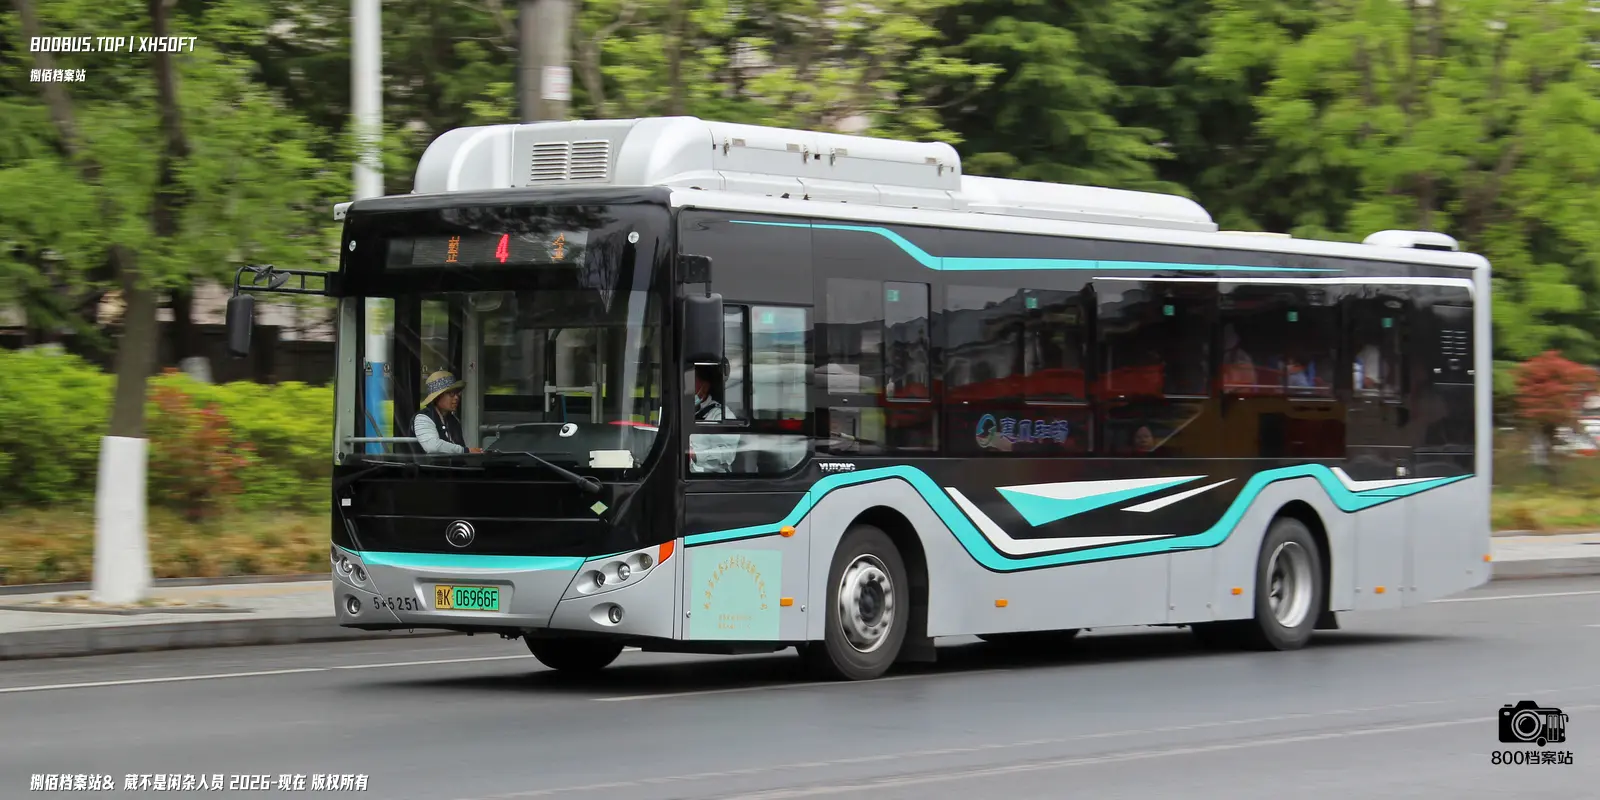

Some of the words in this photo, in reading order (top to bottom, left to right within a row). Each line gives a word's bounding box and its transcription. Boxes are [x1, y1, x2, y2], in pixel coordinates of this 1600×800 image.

[495, 233, 510, 263] 4
[818, 462, 856, 472] YUTONG
[455, 588, 498, 608] 06966F
